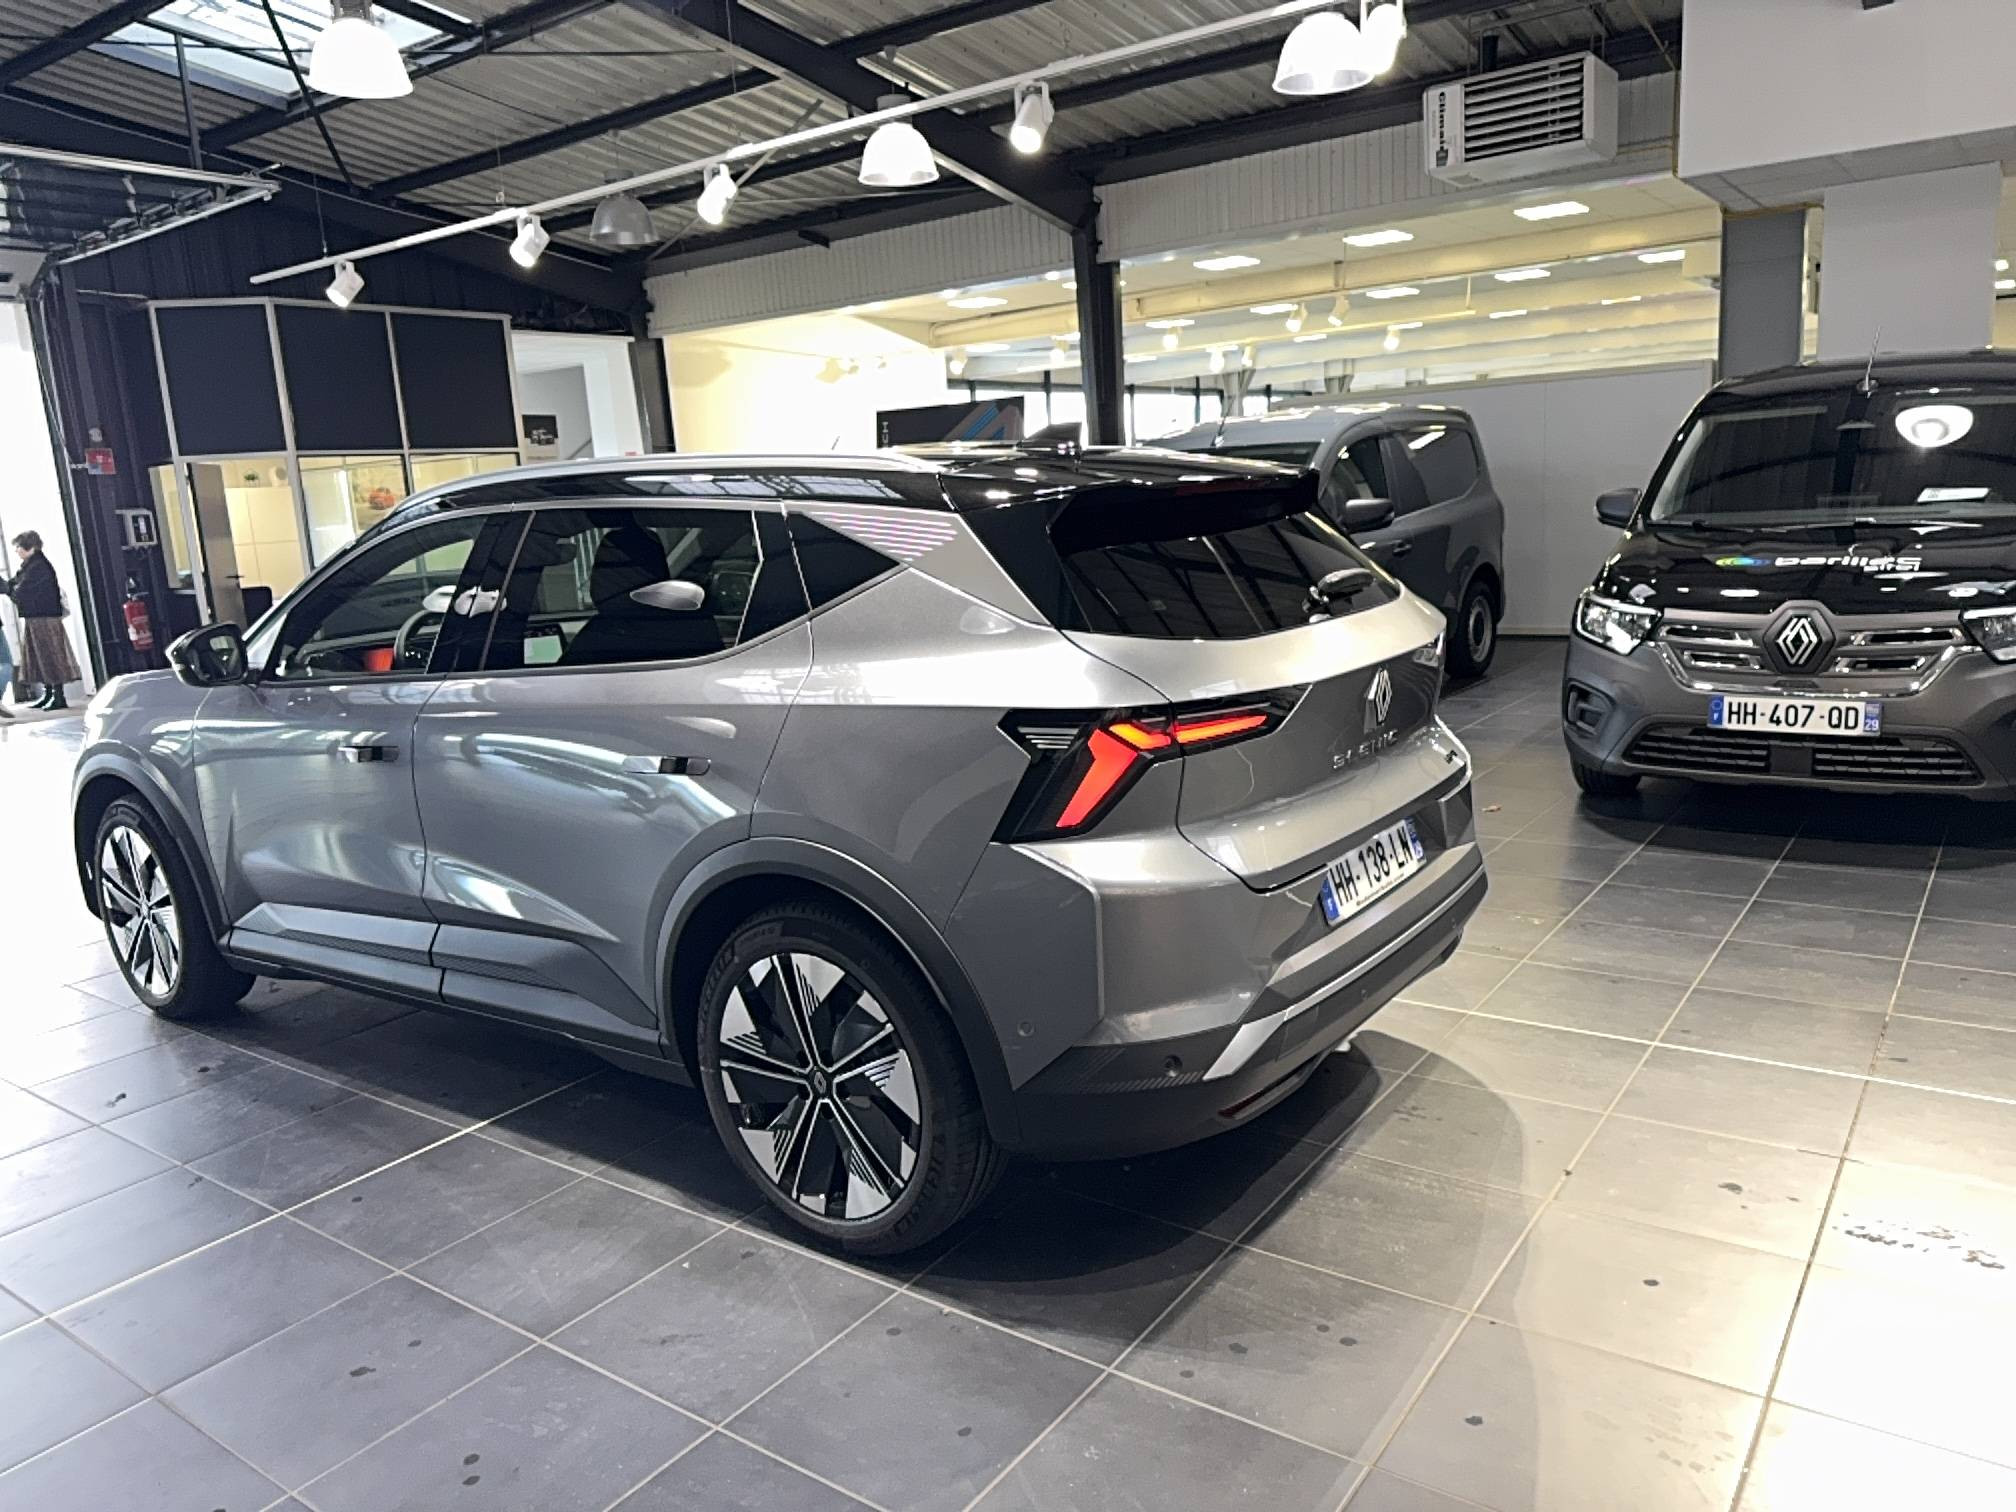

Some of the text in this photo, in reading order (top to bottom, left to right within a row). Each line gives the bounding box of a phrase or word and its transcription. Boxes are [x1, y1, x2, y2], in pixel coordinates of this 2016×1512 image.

[1727, 702, 1859, 730] HH-407-QD
[1865, 718, 1879, 731] 29
[1329, 826, 1413, 906] HH-138-LN
